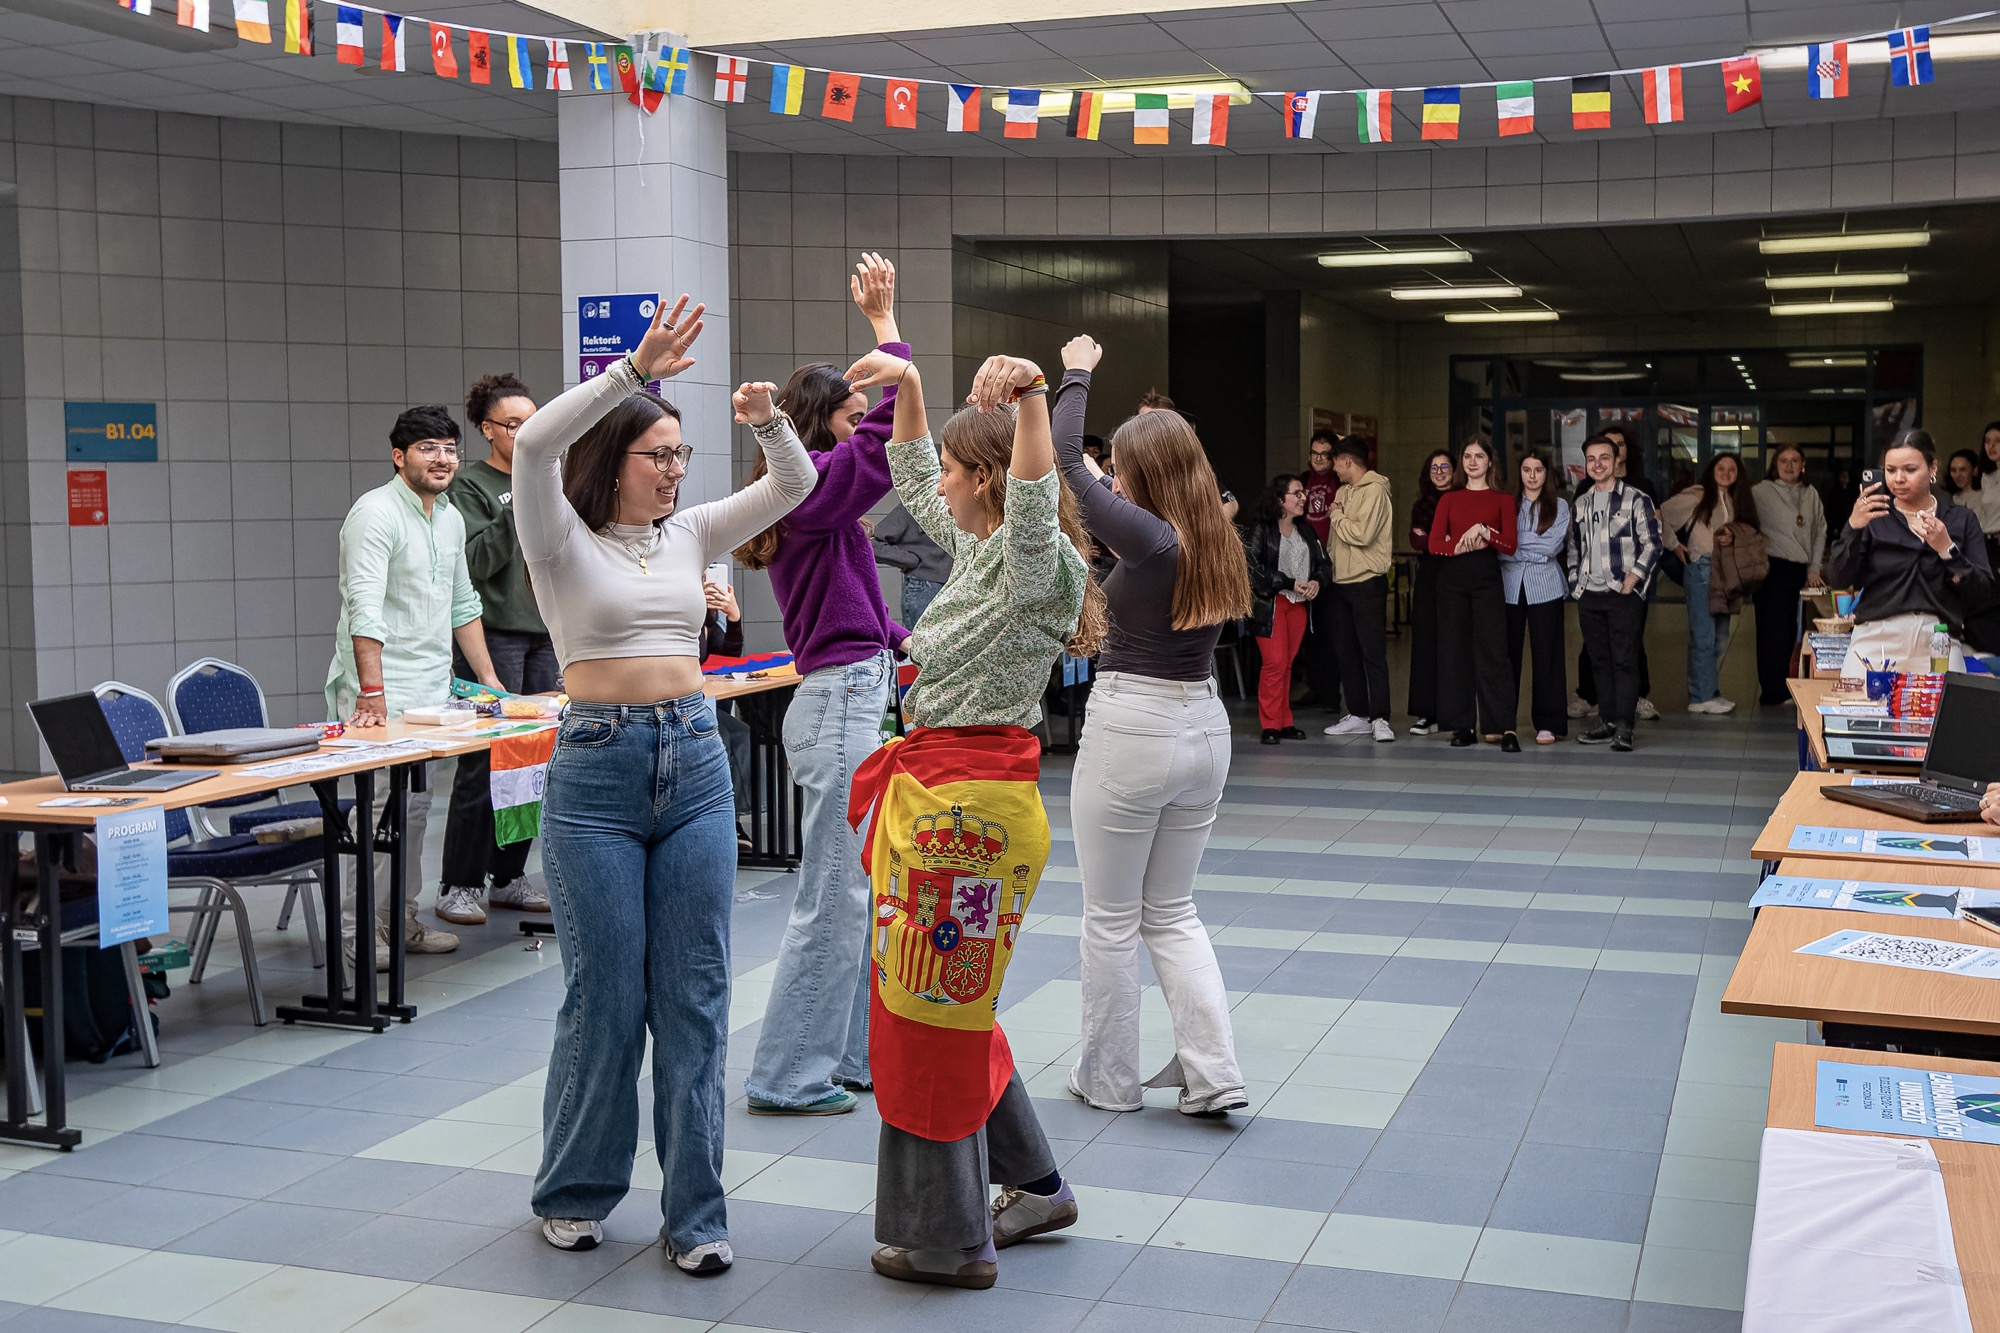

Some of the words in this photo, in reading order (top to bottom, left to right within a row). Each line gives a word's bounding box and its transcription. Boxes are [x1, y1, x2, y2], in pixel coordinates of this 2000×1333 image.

[582, 334, 621, 346] Rektorát
[106, 423, 155, 440] B1.04
[498, 491, 512, 504] ID
[108, 820, 157, 839] PROGRAM
